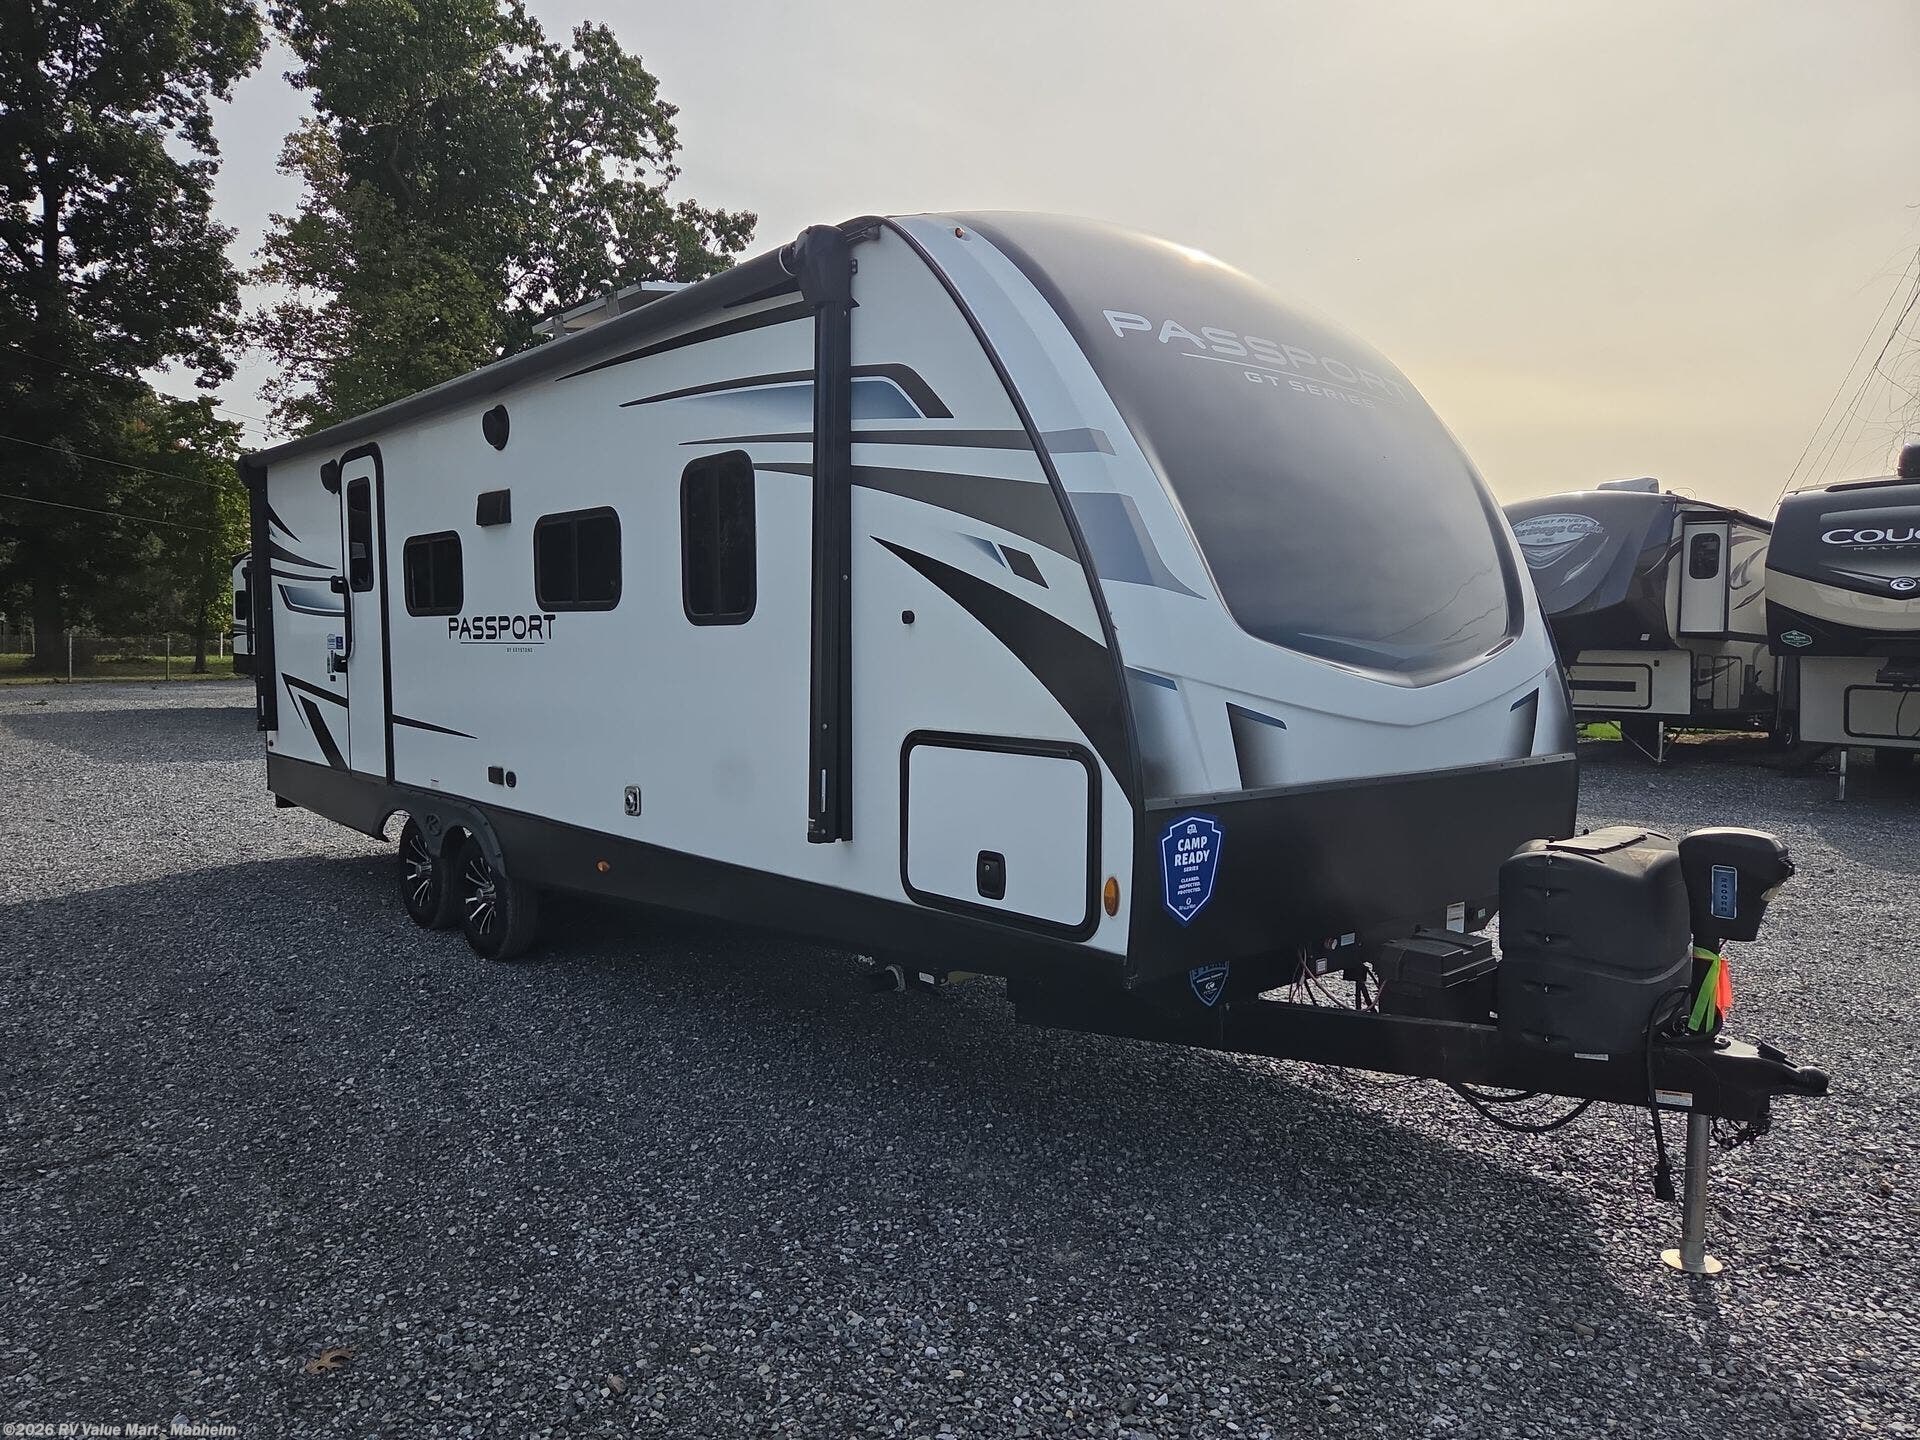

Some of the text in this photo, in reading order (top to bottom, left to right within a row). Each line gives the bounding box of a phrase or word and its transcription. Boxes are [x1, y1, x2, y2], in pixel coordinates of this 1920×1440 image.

[1103, 309, 1409, 402] PASSPORT
[1243, 371, 1377, 408] GT SERIES
[1821, 528, 1920, 544] COU
[448, 614, 556, 639] PASSPORT
[1177, 836, 1208, 851] CAMP
[1174, 849, 1211, 867] READY
